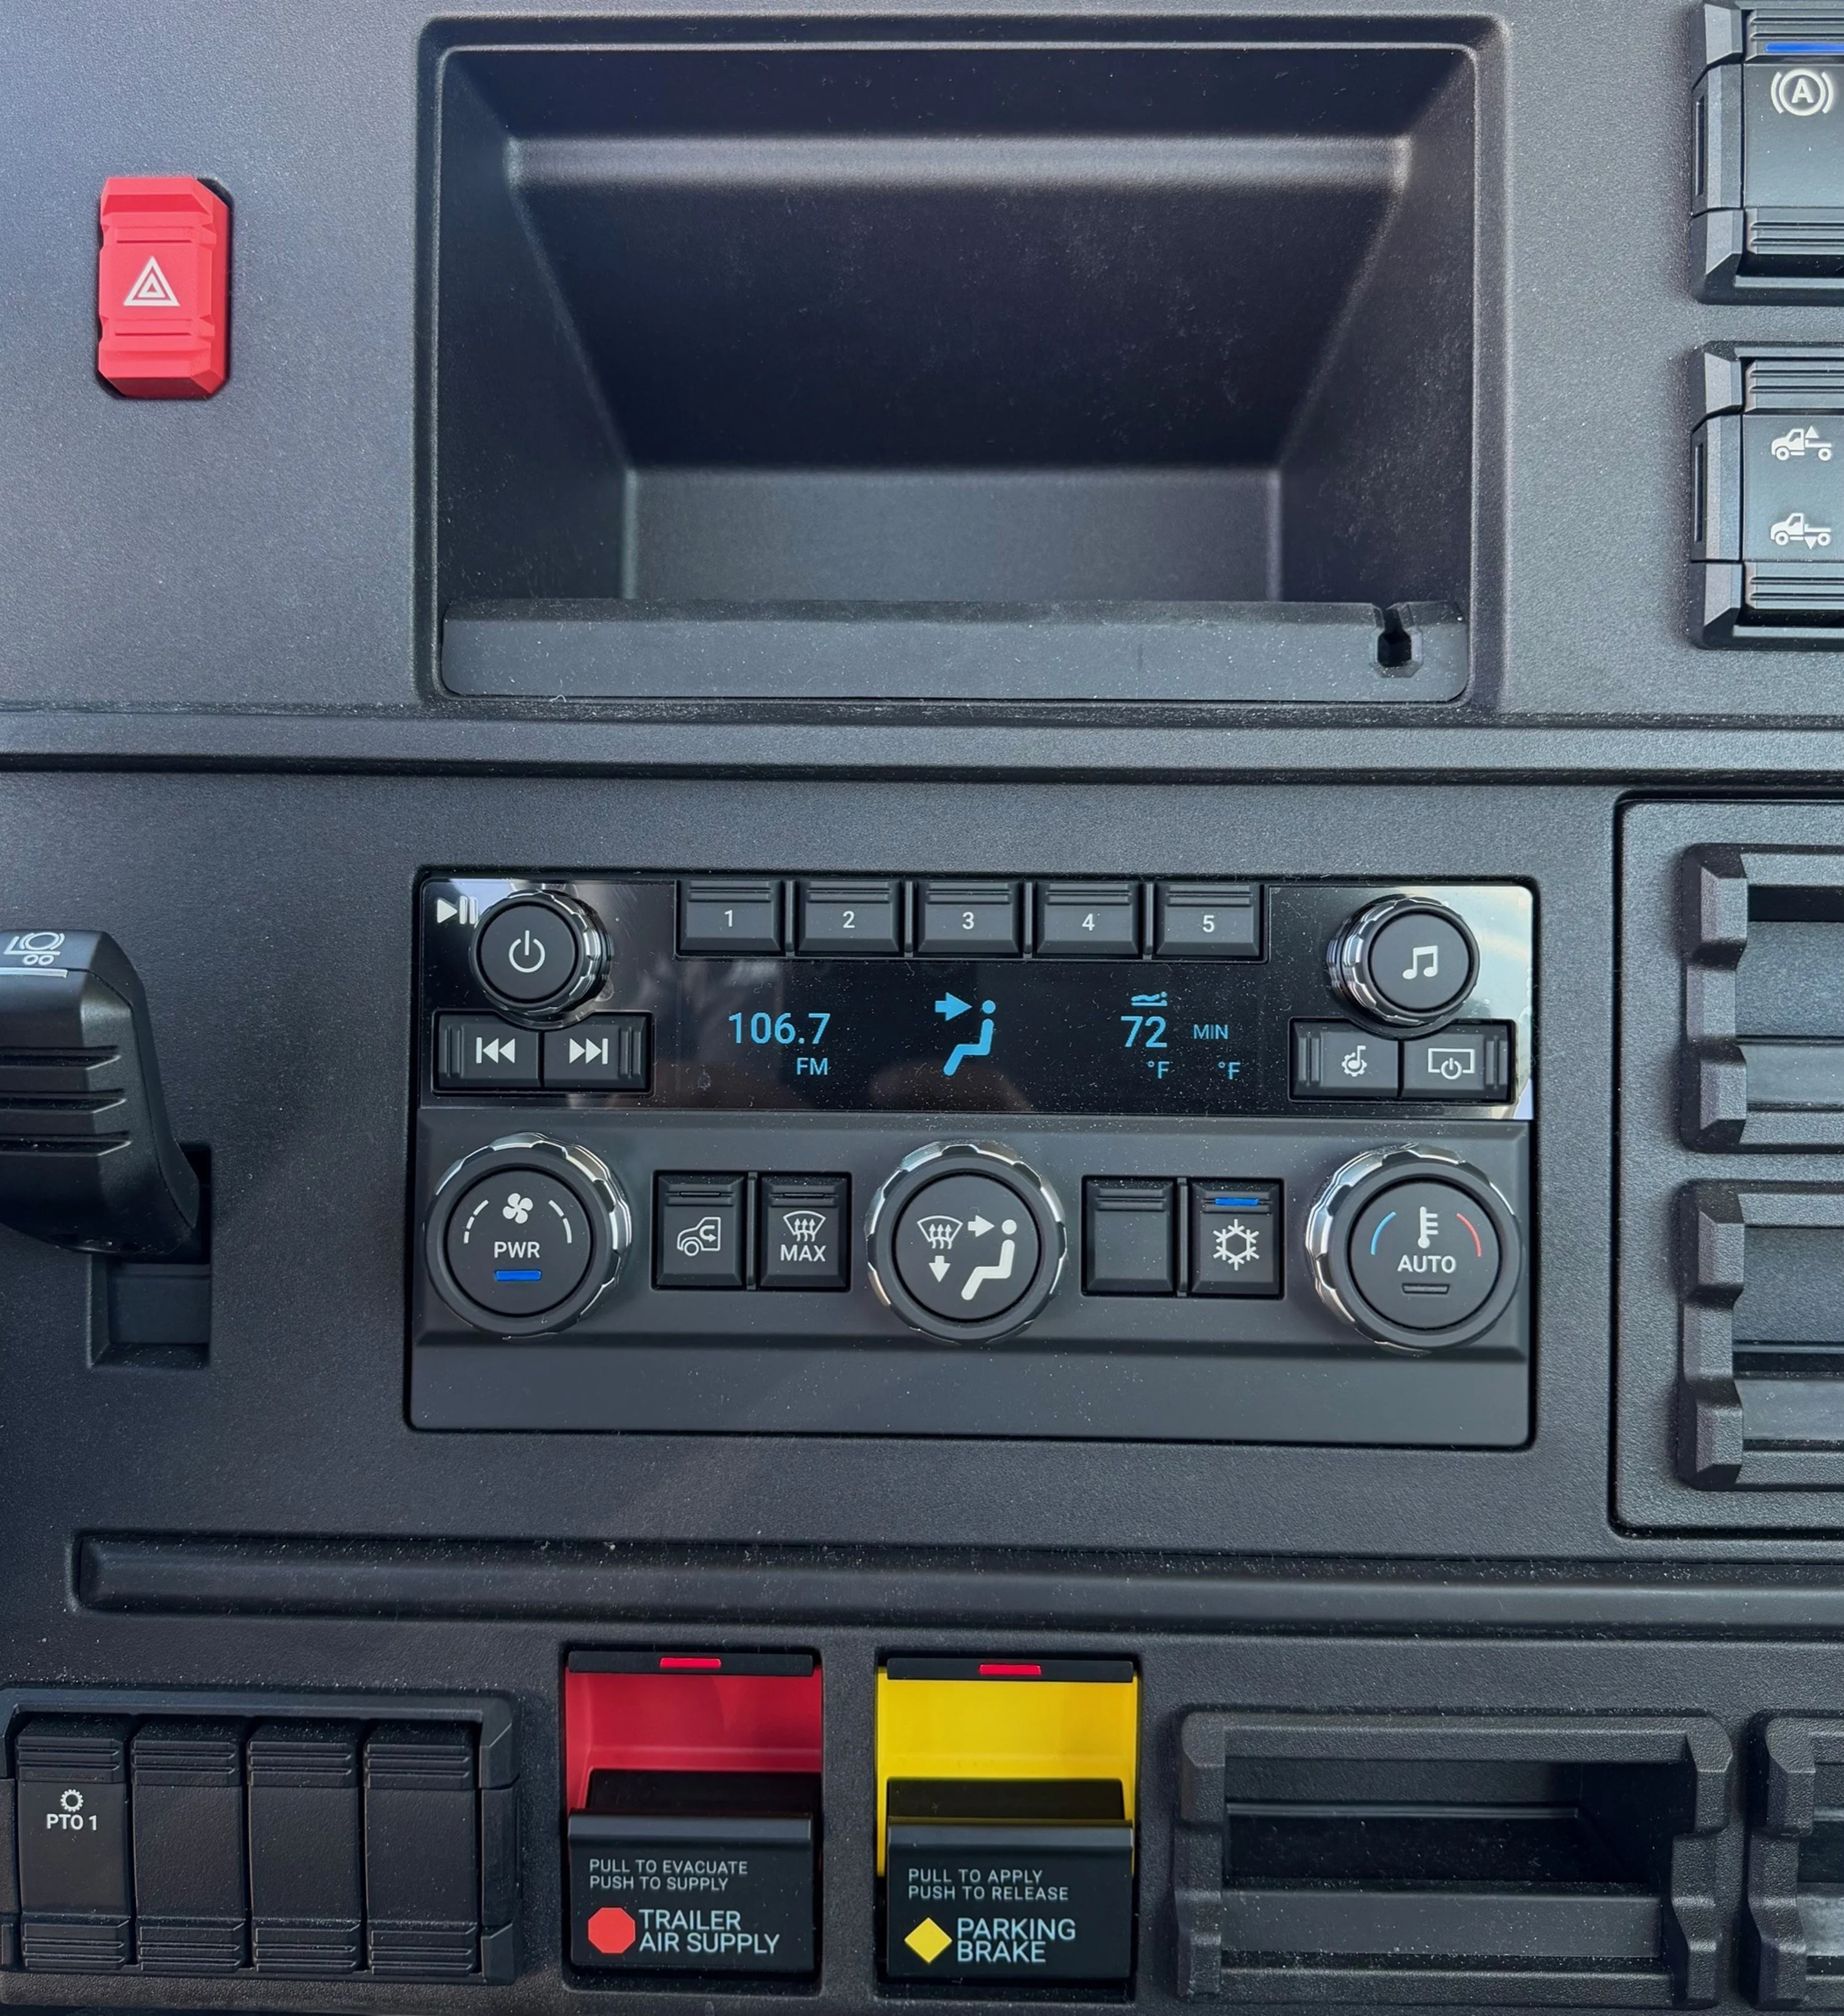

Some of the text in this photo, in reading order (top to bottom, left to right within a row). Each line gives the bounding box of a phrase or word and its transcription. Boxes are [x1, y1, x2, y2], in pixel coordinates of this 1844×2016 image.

[725, 909, 733, 927] 1
[843, 911, 856, 928] 2
[962, 911, 974, 930] 3
[1082, 913, 1095, 931] 4
[1202, 915, 1215, 933] 5
[728, 1012, 830, 1045] 106.7
[1121, 1016, 1167, 1048] 72
[1193, 1024, 1229, 1040] MIN
[797, 1057, 828, 1075] FM
[1147, 1061, 1170, 1079] °F
[1218, 1061, 1241, 1080] °F
[494, 1241, 540, 1259] PWR
[780, 1244, 826, 1262] MAX
[1397, 1254, 1456, 1273] AUTO
[47, 1813, 97, 1831] PTO 1
[589, 1859, 747, 1875] PULL TO EVACUATE
[908, 1868, 1042, 1884] PULL TO APPLY
[590, 1875, 728, 1891] PUSH TO SUPPLY
[908, 1885, 1068, 1901] PUSH TO RELEASE
[638, 1909, 741, 1931] TRAILER
[958, 1918, 1076, 1941] PARKING
[639, 1932, 780, 1954] AIR SUPPLY
[957, 1940, 1046, 1963] BRAKE
